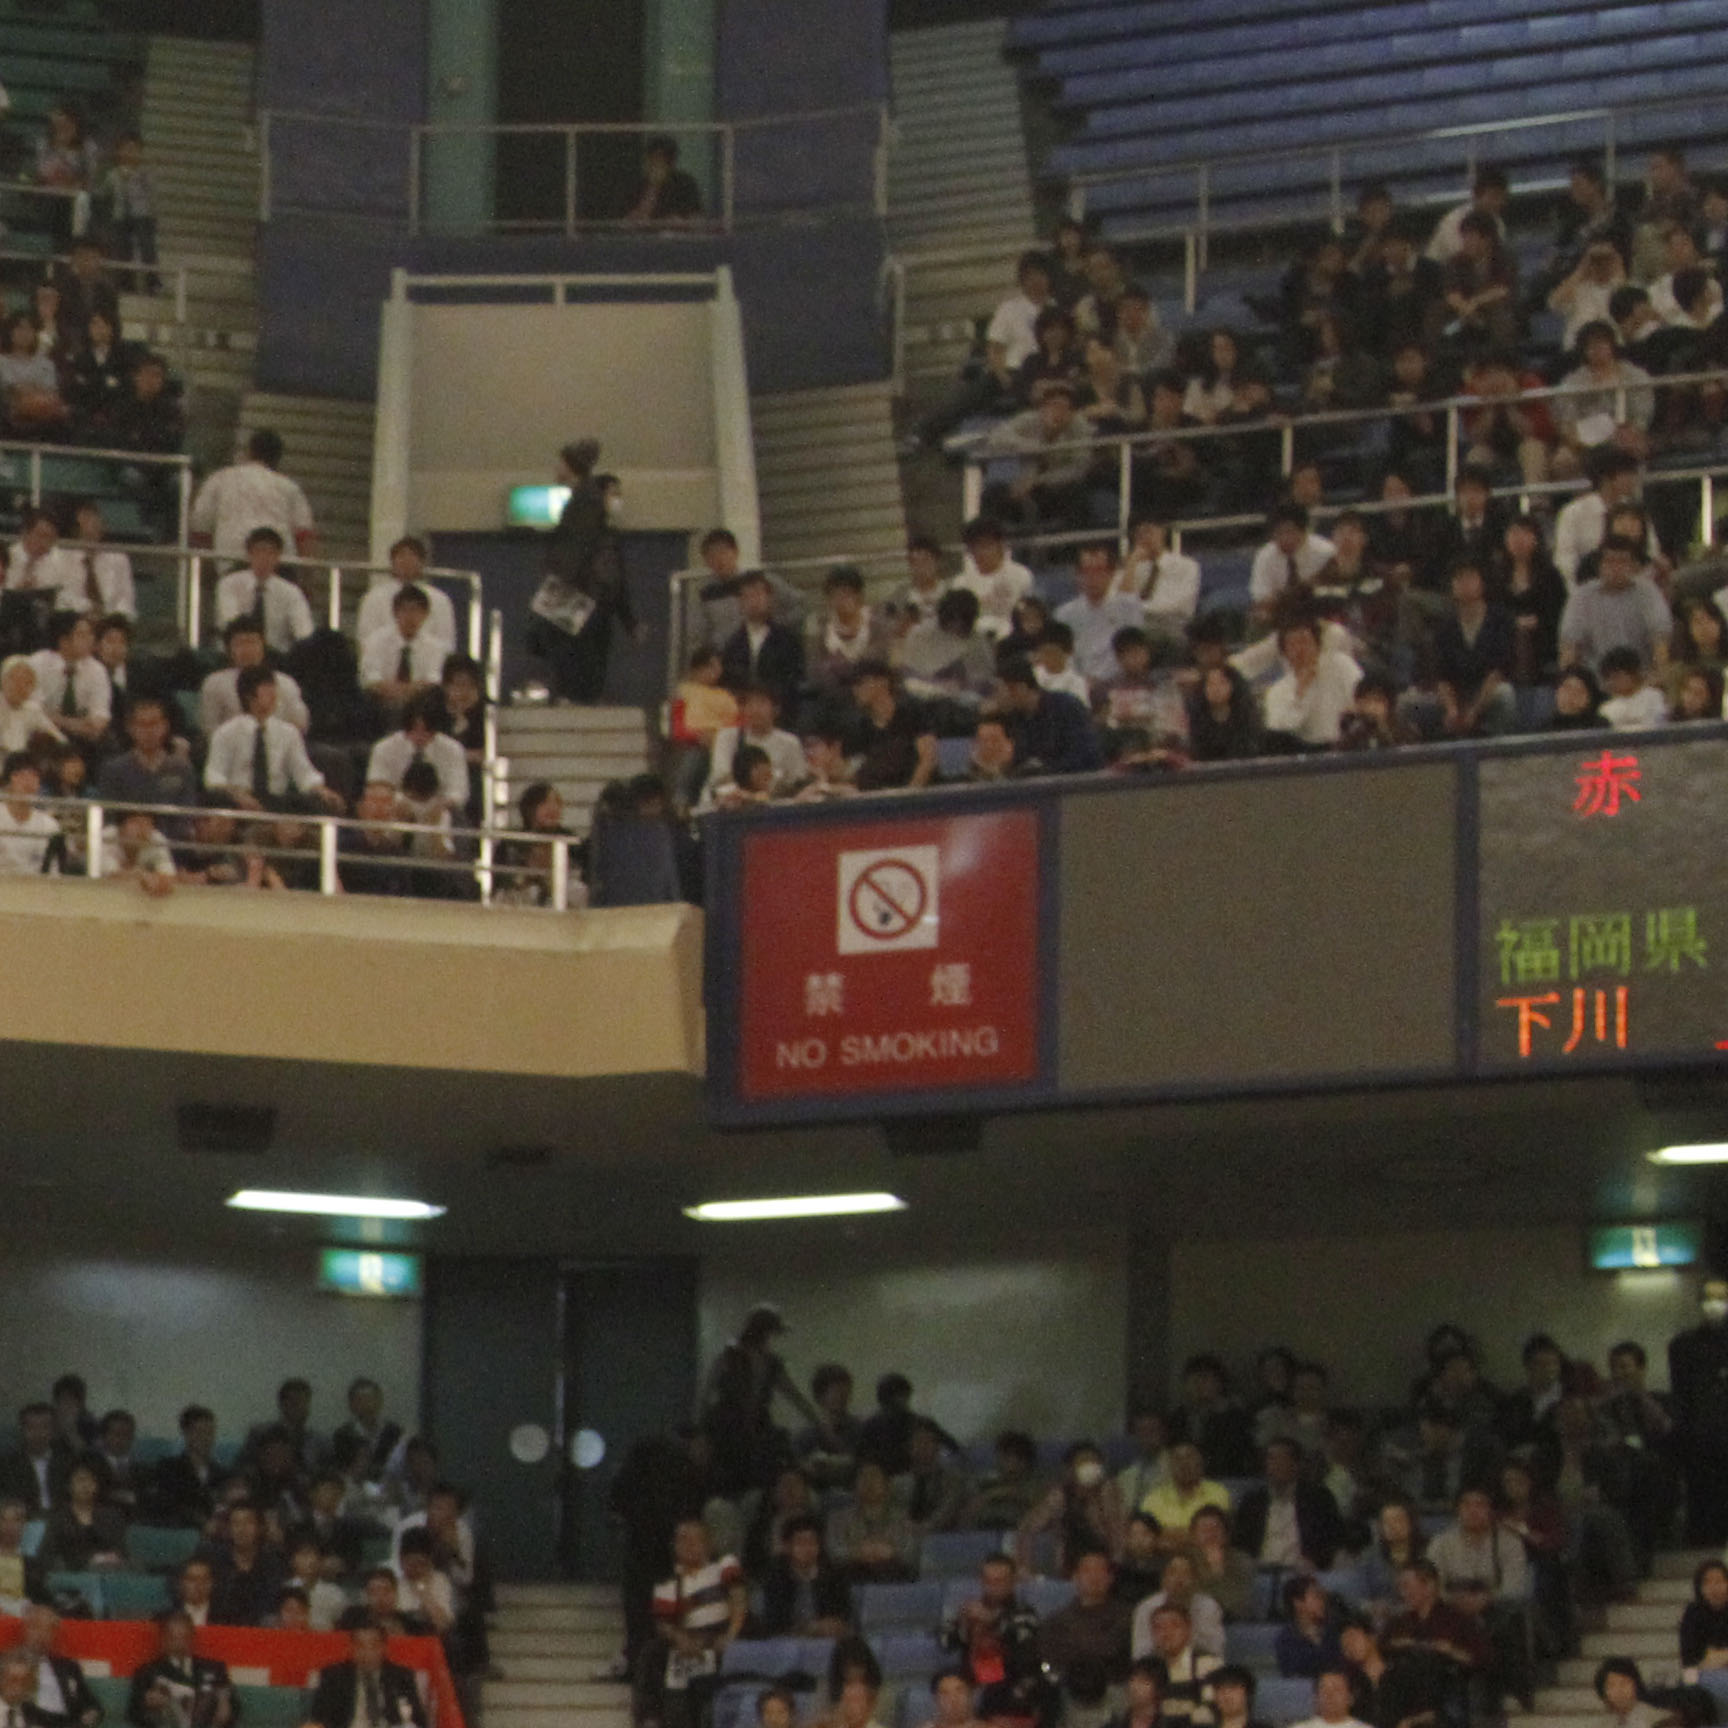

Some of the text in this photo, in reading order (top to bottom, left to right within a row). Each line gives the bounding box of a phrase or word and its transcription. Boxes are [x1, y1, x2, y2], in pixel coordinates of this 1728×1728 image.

[1573, 750, 1641, 818] 赤
[1496, 907, 1708, 985] 福岡県
[805, 963, 972, 1016] 禁煙
[1497, 985, 1628, 1057] 下川
[776, 1026, 998, 1069] NO SMOKING
